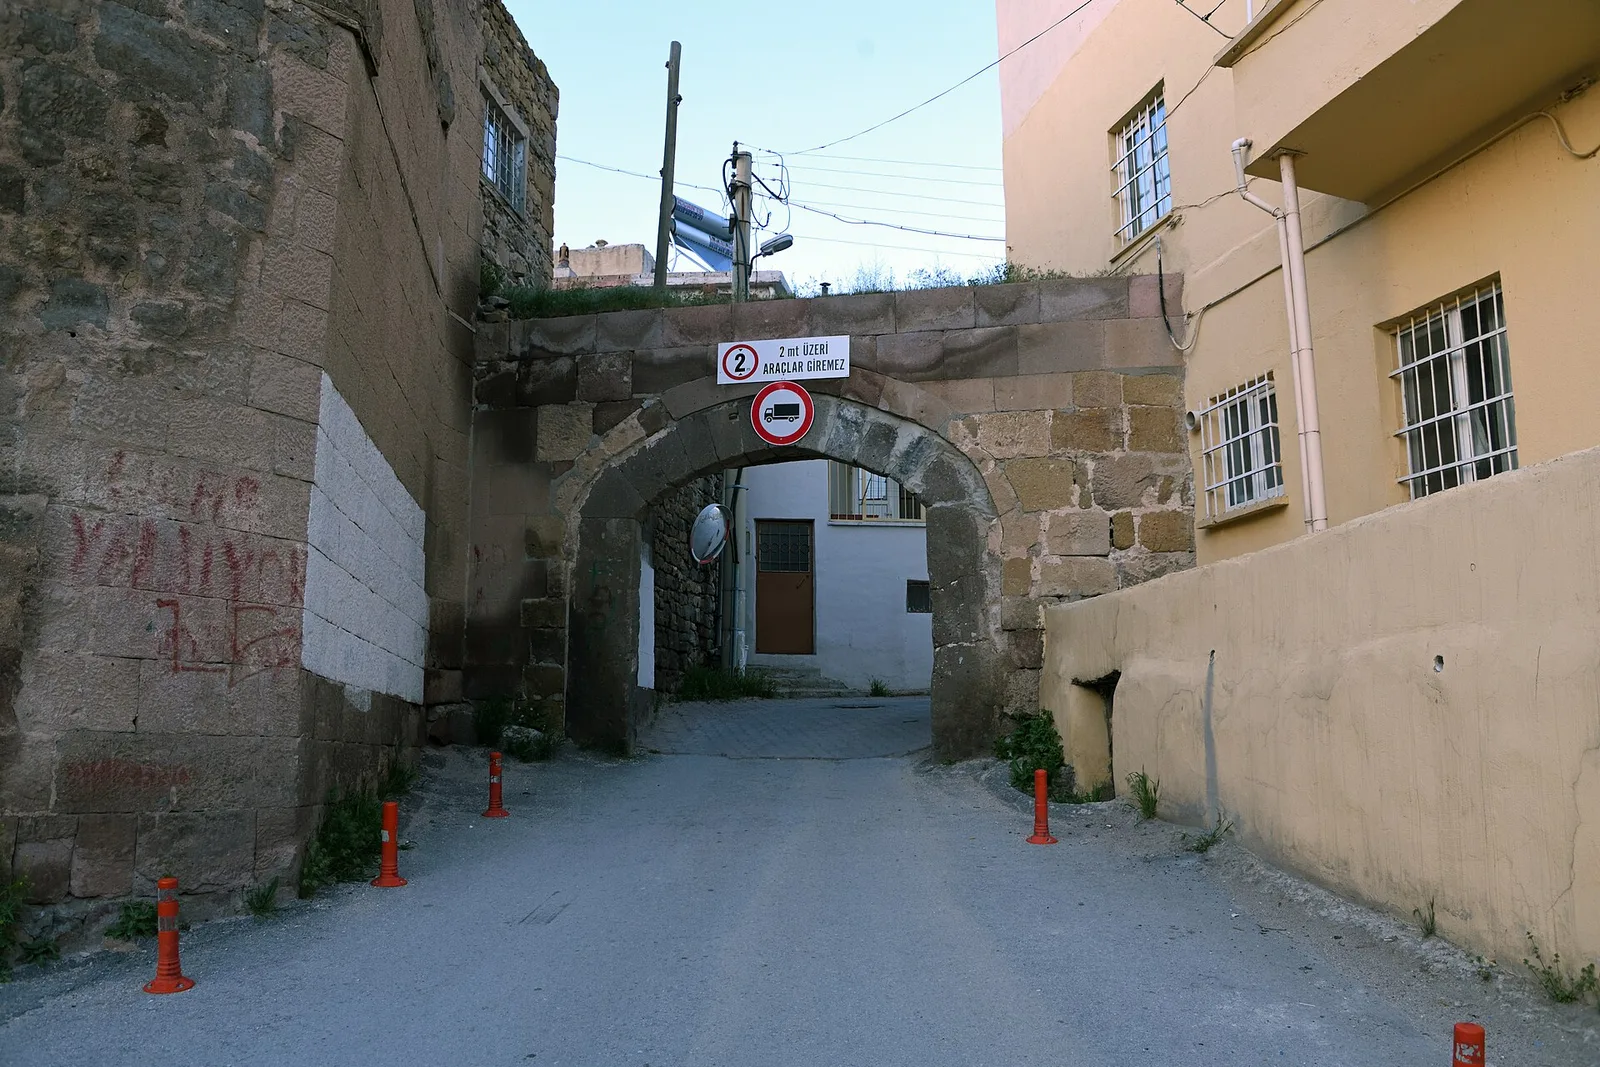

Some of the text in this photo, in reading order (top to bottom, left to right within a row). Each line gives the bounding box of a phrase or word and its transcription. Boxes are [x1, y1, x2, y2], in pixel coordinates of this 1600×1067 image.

[779, 341, 829, 358] 2 mt ÜZERİ
[734, 353, 746, 373] 2
[763, 358, 845, 375] ARAÇLAR GİREMEZ
